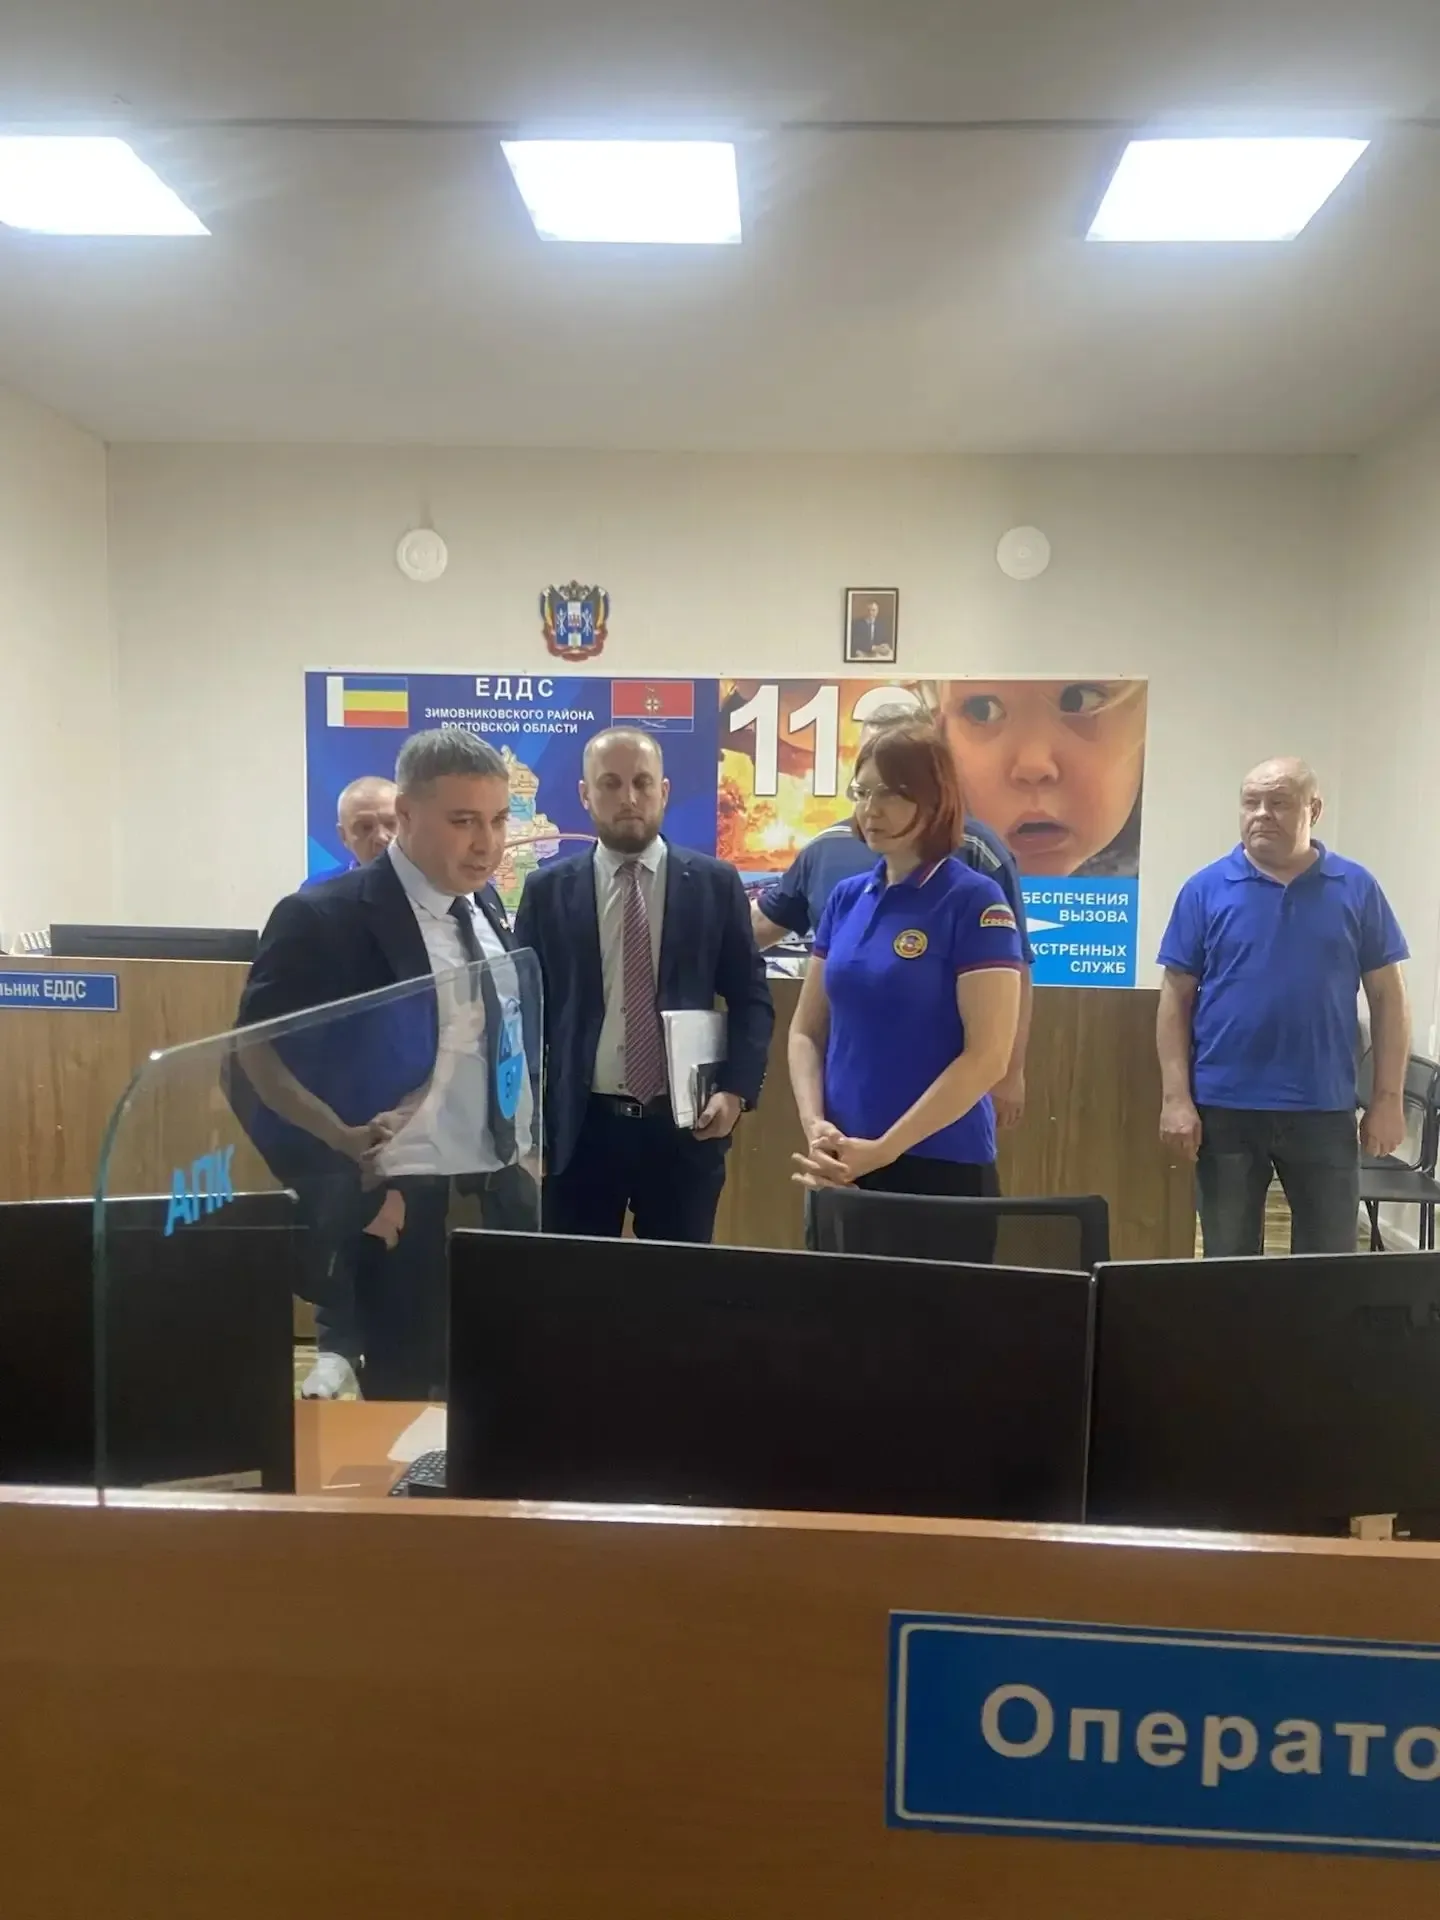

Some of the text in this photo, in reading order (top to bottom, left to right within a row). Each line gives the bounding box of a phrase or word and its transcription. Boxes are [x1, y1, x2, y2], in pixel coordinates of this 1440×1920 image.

[475, 677, 554, 701] ЕДДС
[425, 708, 595, 721] ЗИМОВНИКОВСКОГО РАЙОНА
[522, 722, 578, 734] ОБЛАСТИ
[1021, 892, 1128, 905] БЕСПЕЧЕНИЯ
[1060, 910, 1128, 923] ВЫЗОВА
[1030, 943, 1127, 957] КСТРЕННЫХ
[1070, 961, 1126, 974] СЛУЖБ
[43, 979, 87, 1002] ЕДДС
[164, 1145, 235, 1237] АПК
[980, 1683, 1440, 1786] Операто
